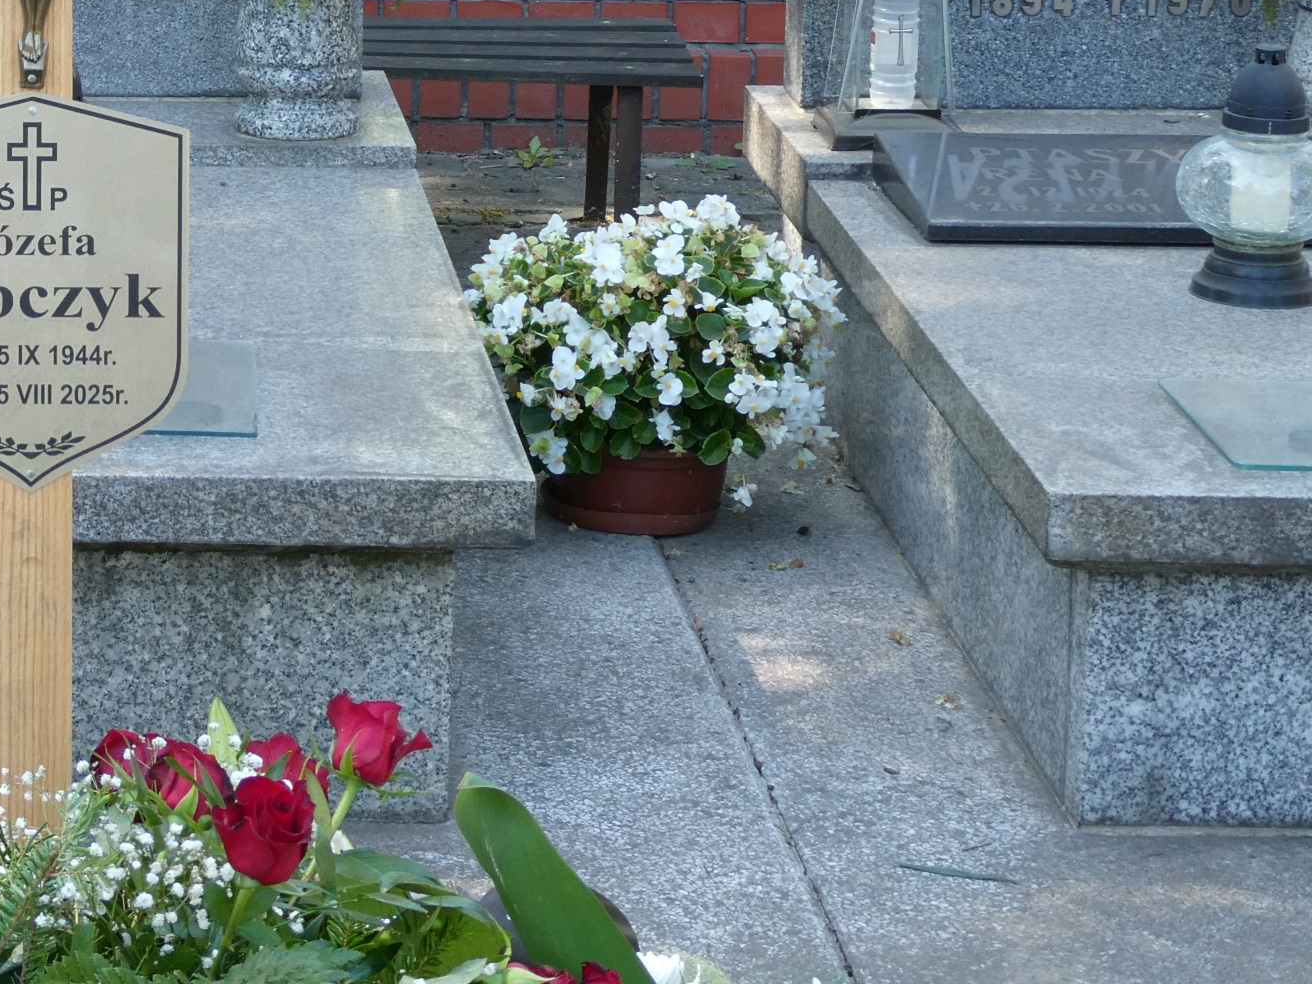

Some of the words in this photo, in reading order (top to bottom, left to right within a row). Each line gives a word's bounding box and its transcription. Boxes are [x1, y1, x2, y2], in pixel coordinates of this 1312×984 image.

[50, 187, 68, 211] P
[18, 345, 41, 366] IX
[48, 345, 118, 366] 1944r.
[16, 384, 52, 405] VIII
[60, 384, 129, 405] 2025r.
